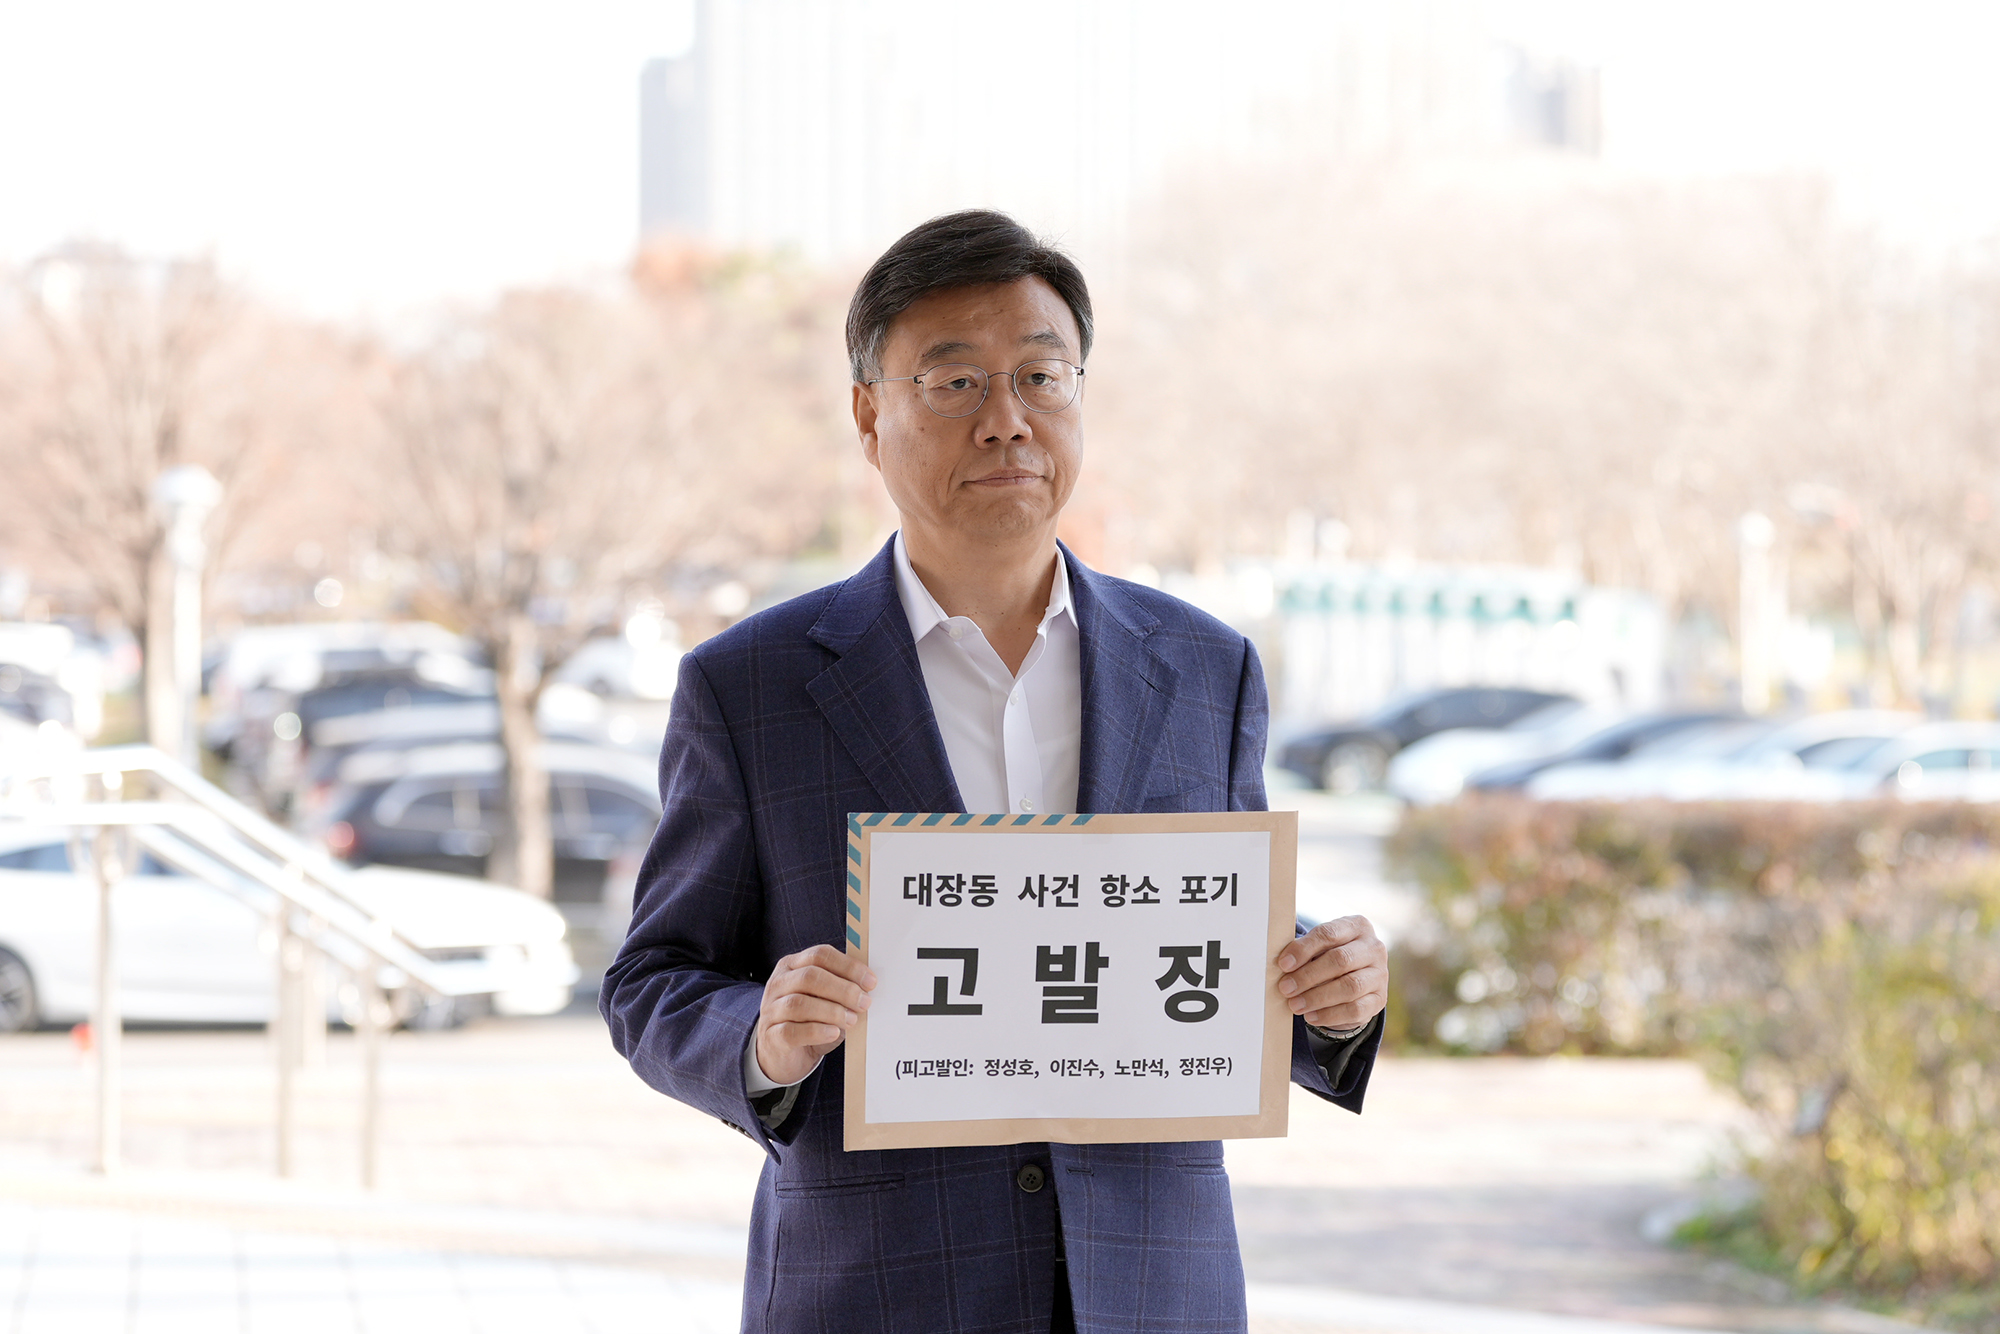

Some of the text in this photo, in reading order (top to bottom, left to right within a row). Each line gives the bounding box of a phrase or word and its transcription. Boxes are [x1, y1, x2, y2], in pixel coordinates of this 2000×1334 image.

[902, 872, 1239, 908] 대장동 사건 항소 포기
[895, 1056, 1233, 1080] (피고발인: 정성호, 이진수, 노만석, 정진우)
